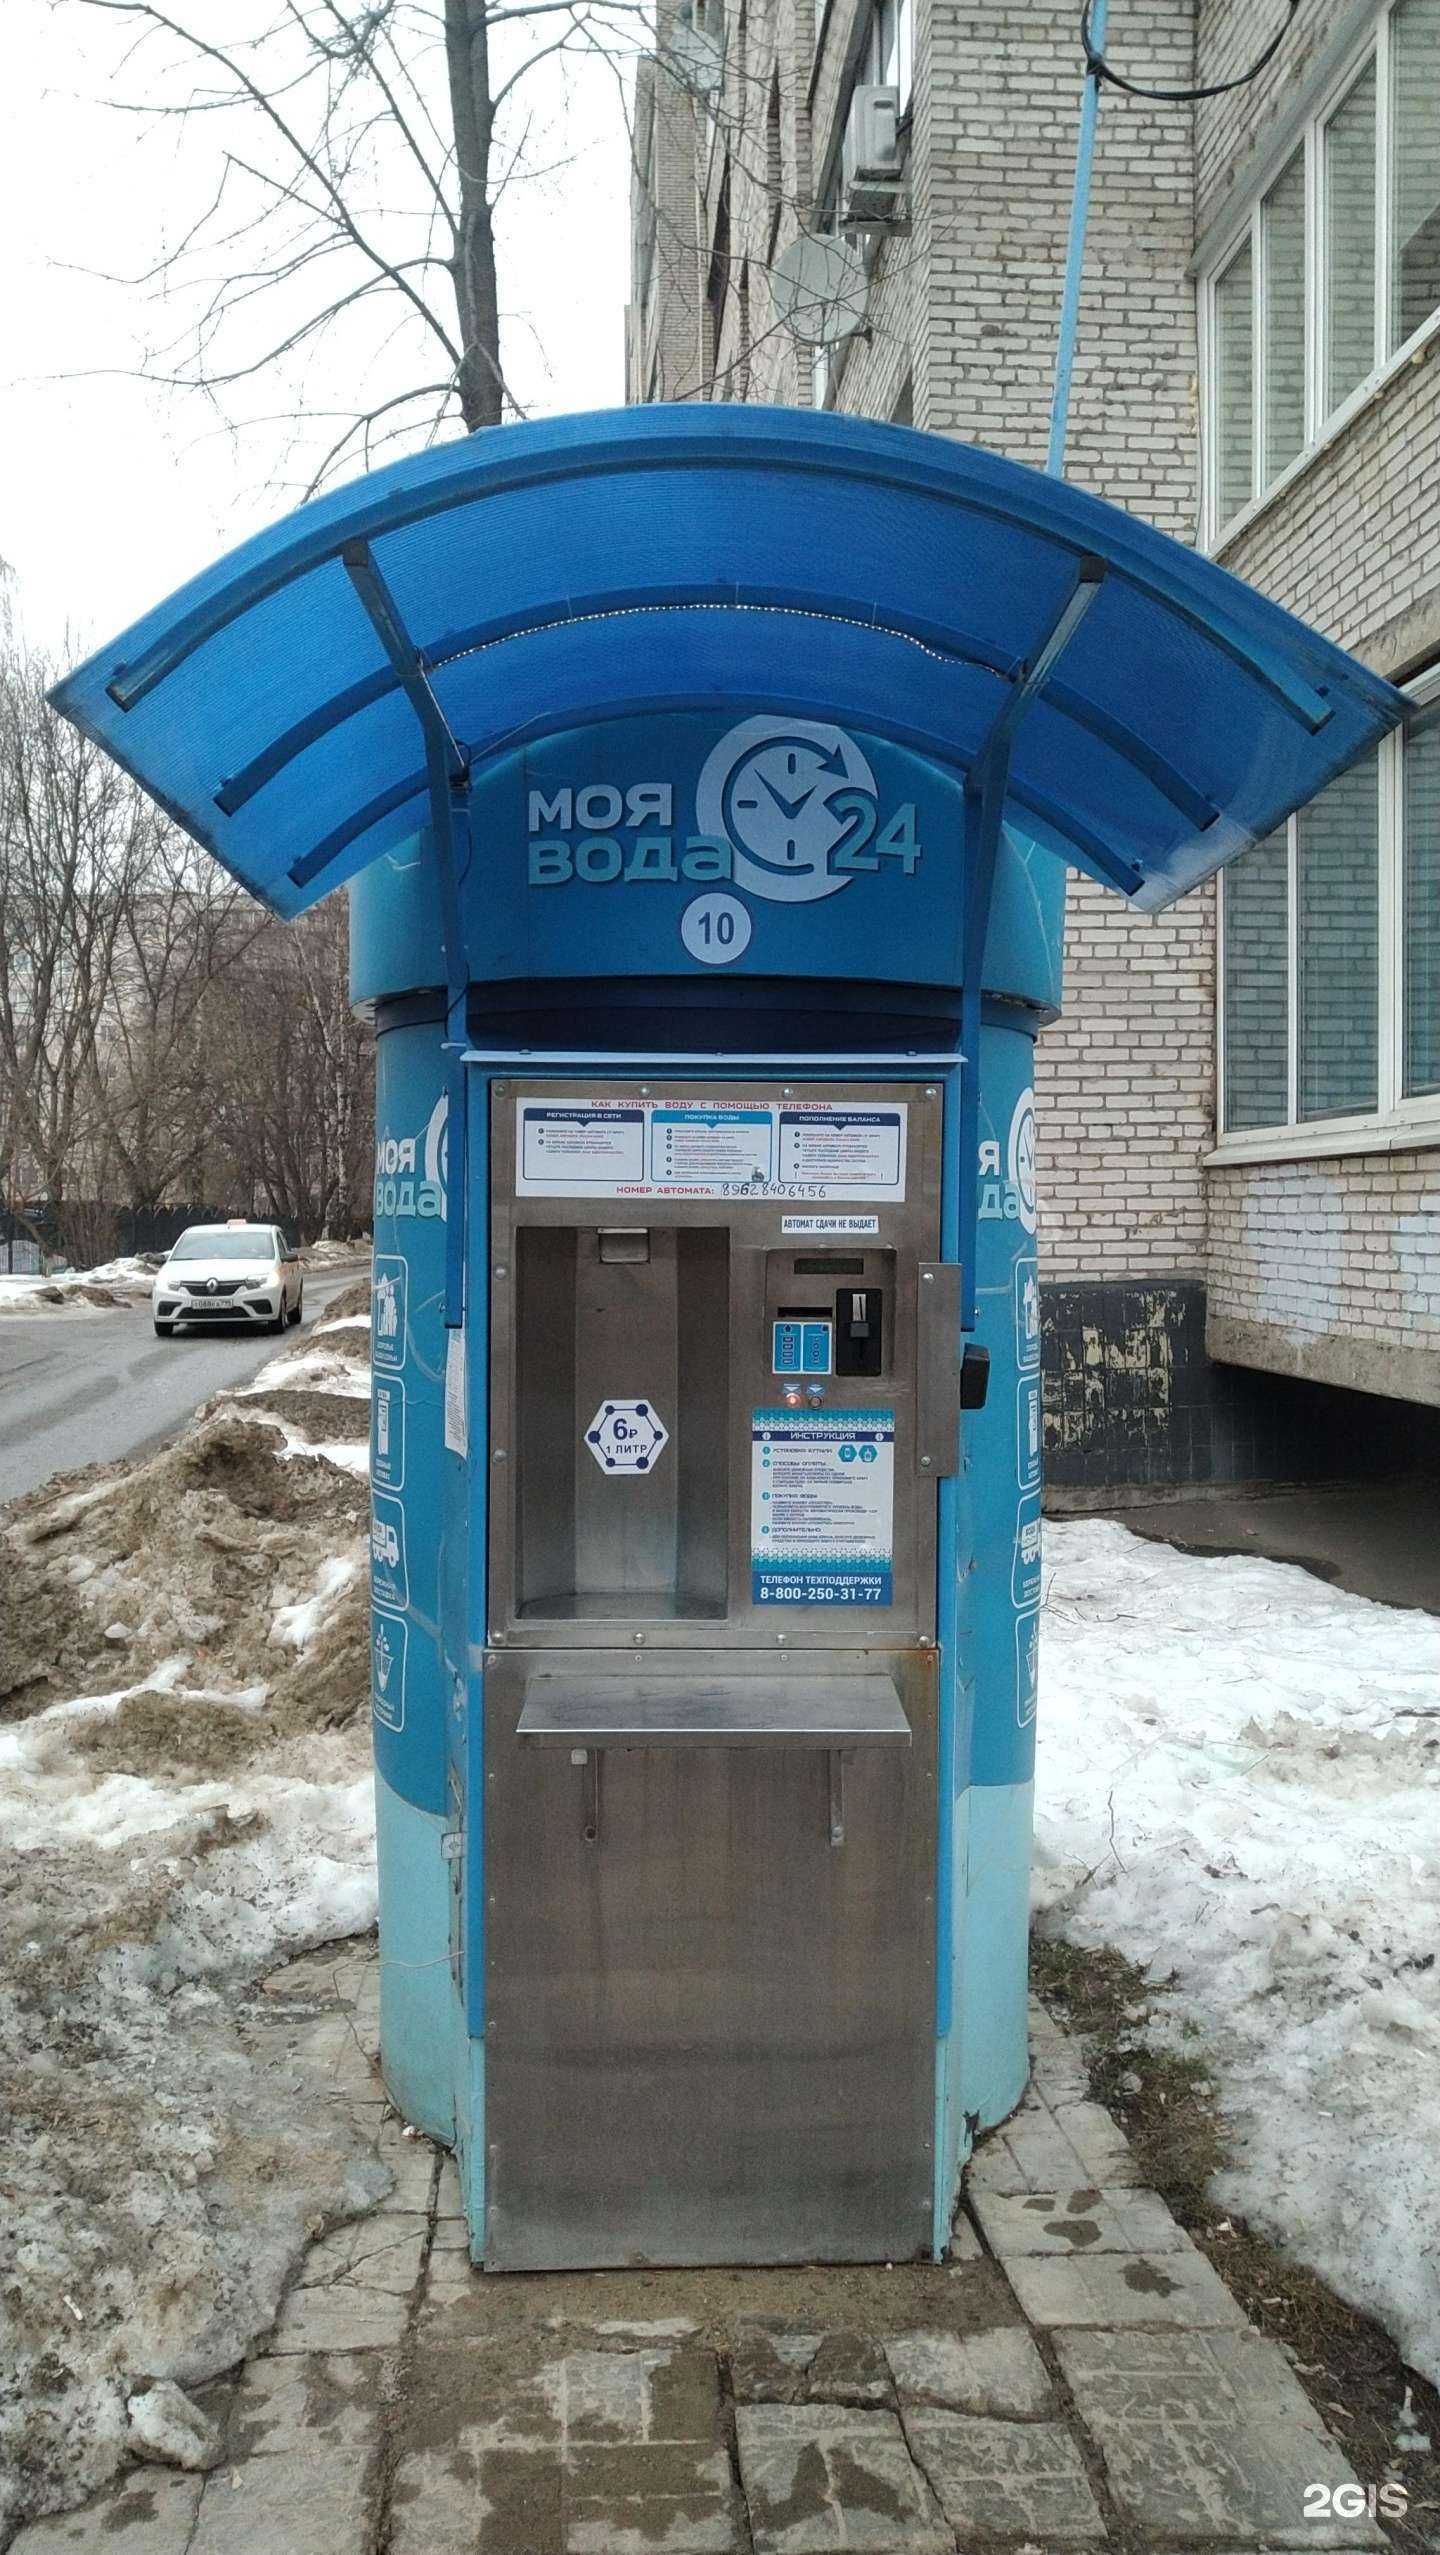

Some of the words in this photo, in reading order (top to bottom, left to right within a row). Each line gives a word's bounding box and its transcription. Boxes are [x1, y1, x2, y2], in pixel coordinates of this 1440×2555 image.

[834, 796, 922, 874] 24
[697, 912, 735, 945] 10
[617, 1101, 658, 1109] КУПИТЬ
[664, 1102, 694, 1110] ВОДУ
[713, 1102, 770, 1110] ПОМОЩЬЮ
[776, 1103, 833, 1111] ТЕЛЕФОНА
[616, 1186, 653, 1194] НОМЕР
[657, 1187, 715, 1195] АВТОМАТА:
[722, 1182, 827, 1198] 89628406456
[783, 1219, 814, 1229] АВТОМАТ
[815, 1219, 837, 1229] СДАЧИ
[838, 1219, 847, 1229] НЕ
[848, 1219, 877, 1229] ВЫДАЕТ
[790, 1432, 856, 1440] ИНСТРУКЦИЯ
[605, 1445, 611, 1454] 1
[615, 1444, 648, 1454] ЛИТР
[760, 1575, 804, 1584] ТЕЛЕФОН
[805, 1575, 882, 1586] ТЕХПОДДЕРЖКИ
[760, 1587, 882, 1600] 8-800-250-31-77
